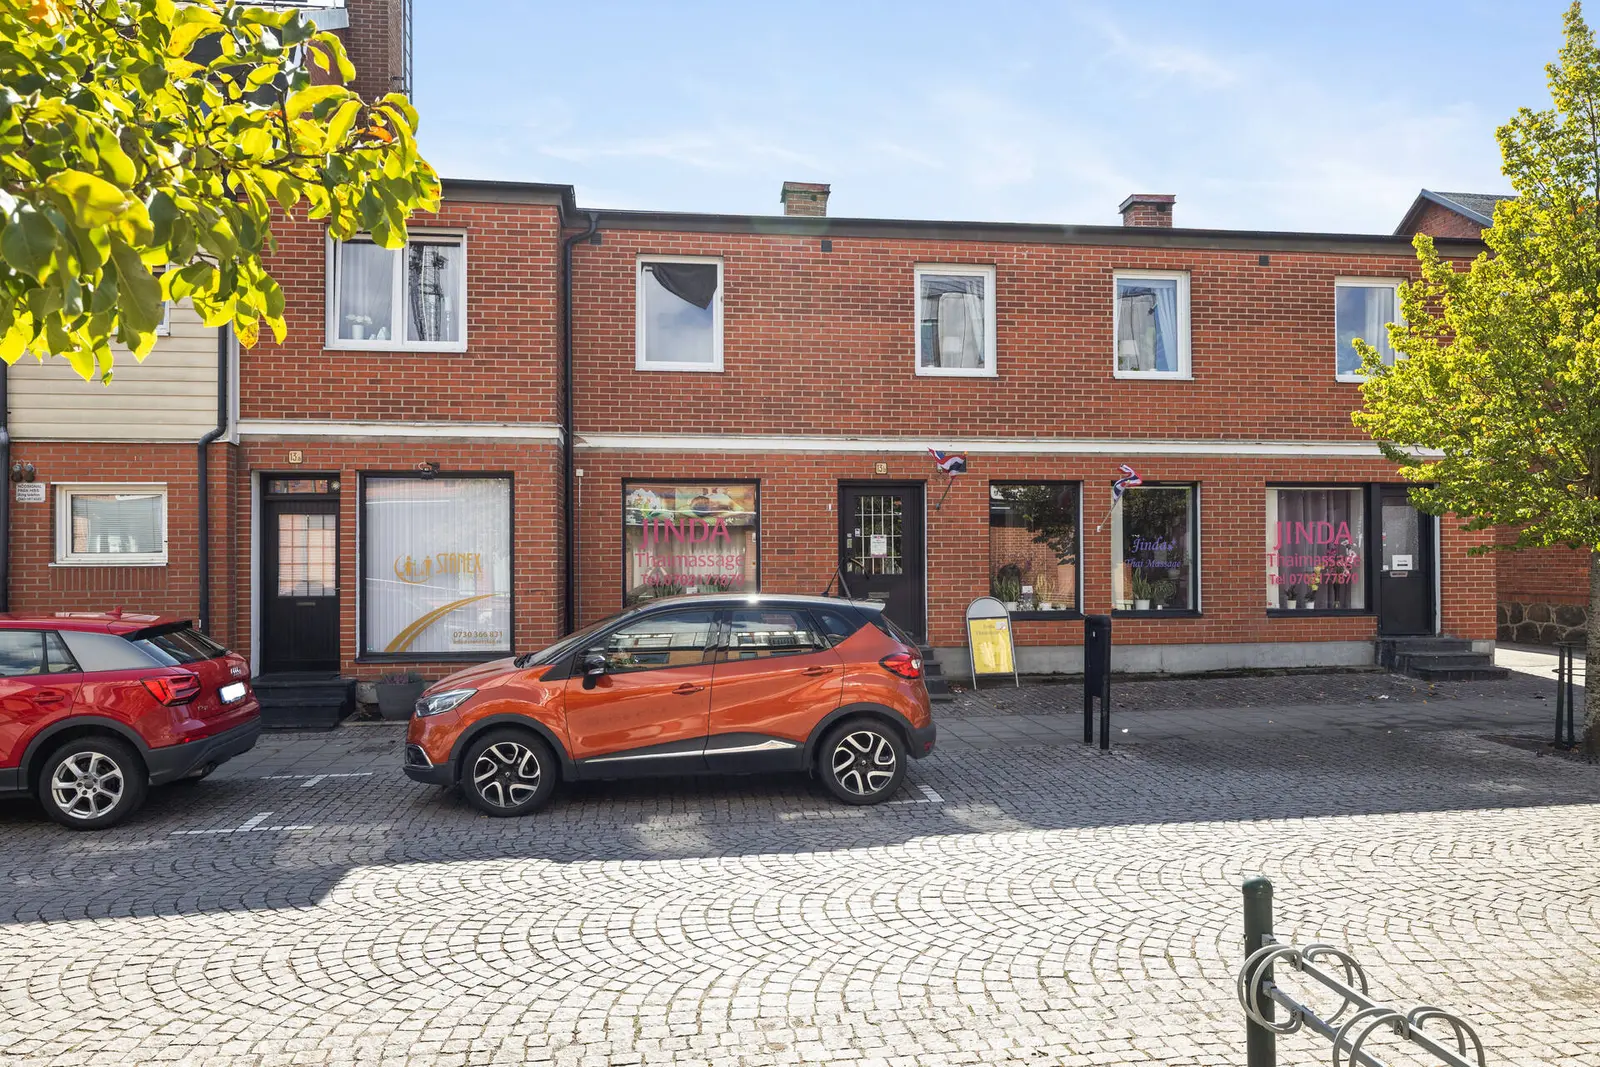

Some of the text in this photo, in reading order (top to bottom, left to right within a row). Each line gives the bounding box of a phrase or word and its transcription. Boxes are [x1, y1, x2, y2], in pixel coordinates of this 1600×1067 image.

[638, 517, 732, 550] JINDA
[1272, 520, 1354, 551] JINDA
[1131, 536, 1168, 553] Jinda
[435, 552, 483, 575] STANEX
[634, 552, 746, 571] Thaimassage
[1147, 559, 1181, 568] Massage
[1267, 553, 1362, 570] Thaimassage
[453, 631, 473, 639] 0730
